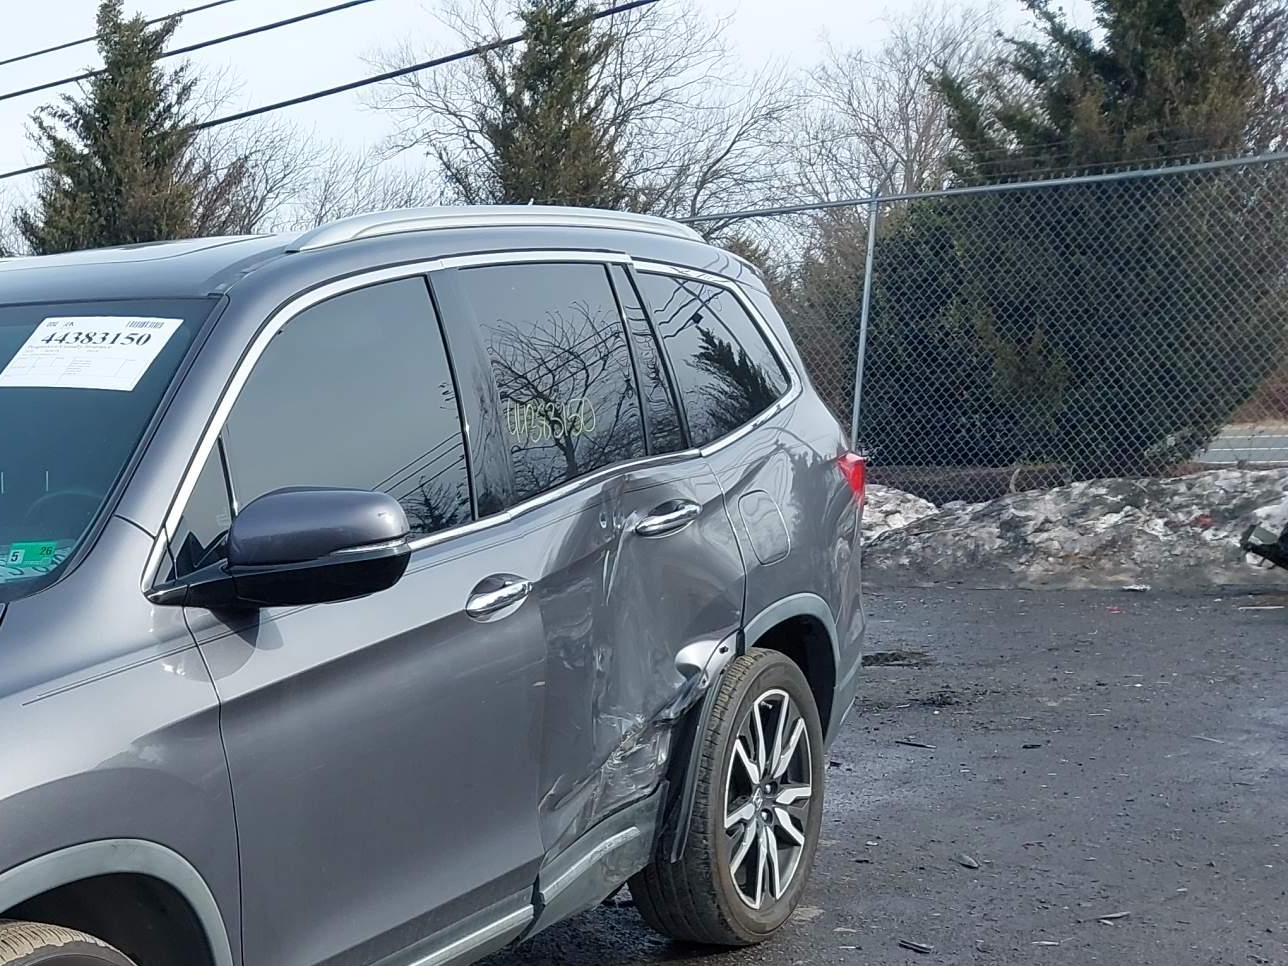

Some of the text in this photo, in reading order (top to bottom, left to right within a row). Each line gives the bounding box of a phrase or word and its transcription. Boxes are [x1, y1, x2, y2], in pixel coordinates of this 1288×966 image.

[41, 331, 152, 346] 44383150
[10, 551, 20, 563] 5
[39, 546, 53, 556] 26
